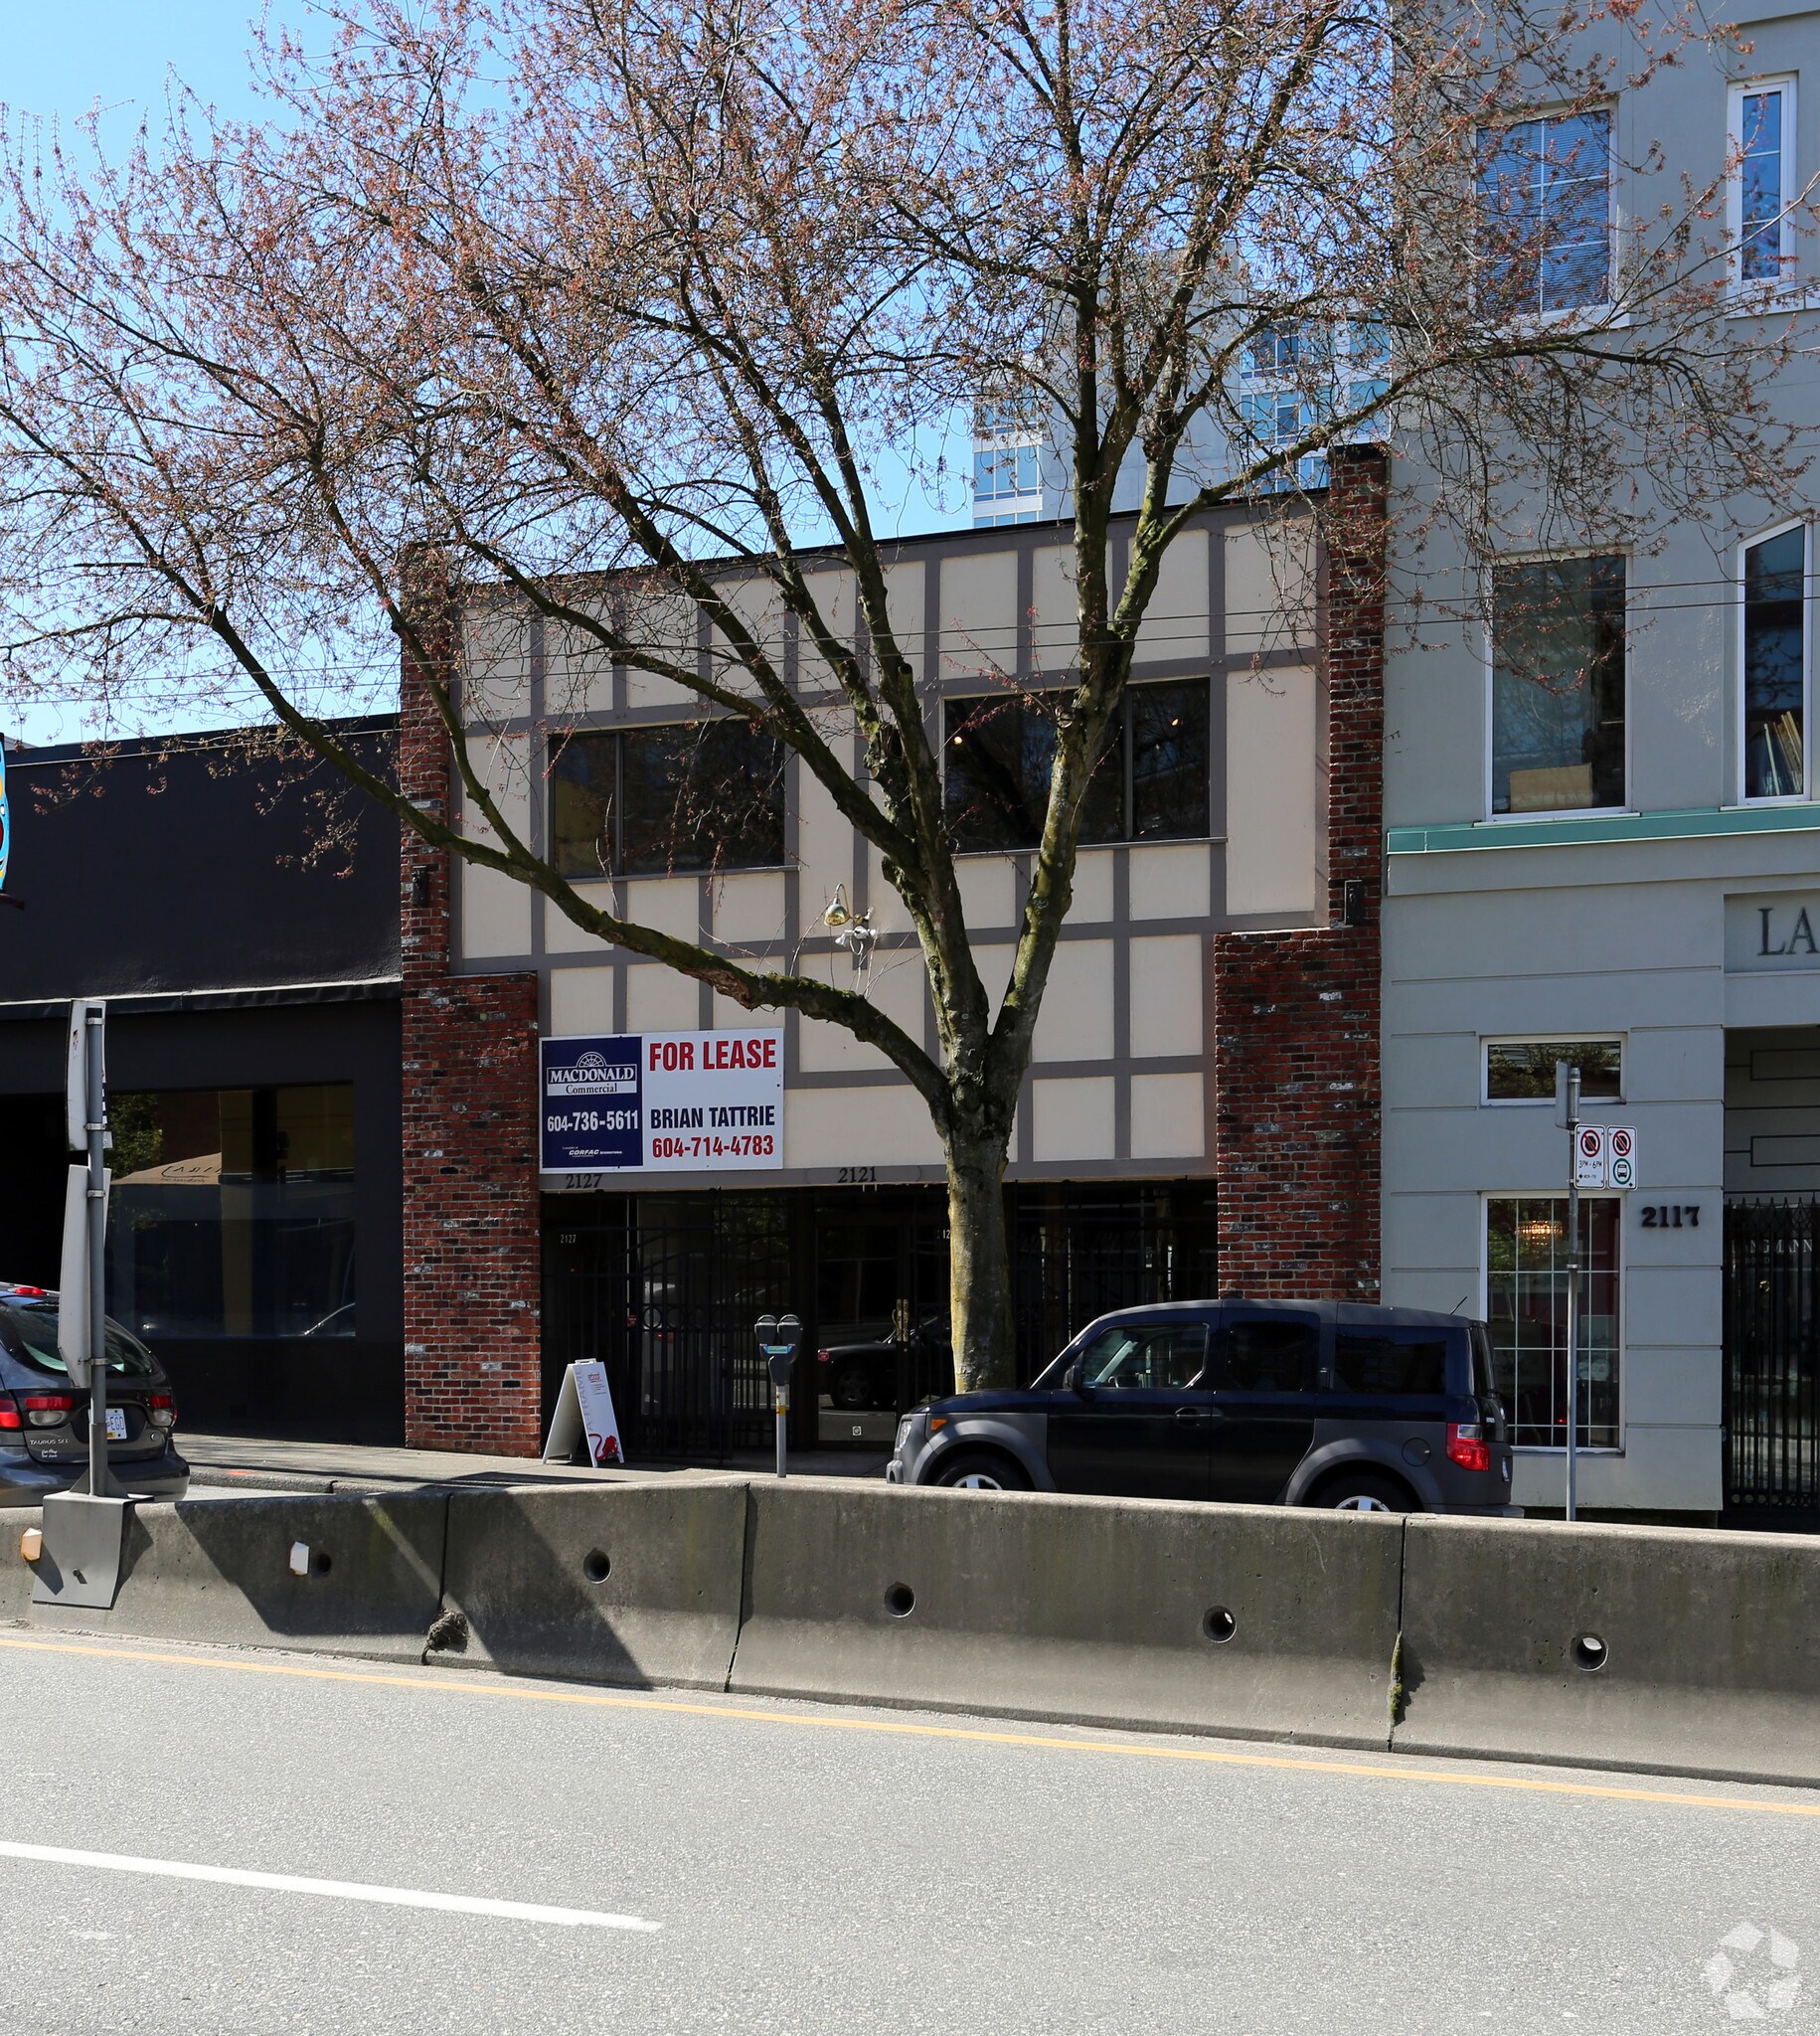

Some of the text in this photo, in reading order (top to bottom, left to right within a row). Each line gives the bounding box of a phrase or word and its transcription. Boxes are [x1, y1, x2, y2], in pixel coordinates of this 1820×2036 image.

[1757, 907, 1820, 955] LA
[650, 1039, 776, 1071] FOR LEASE
[550, 1067, 634, 1084] MACDONALD
[566, 1083, 617, 1095] Commercial
[547, 1109, 638, 1131] 604-736-5611
[650, 1105, 775, 1129] BRIAN TATTRIE
[652, 1134, 773, 1158] 604-714-4783
[566, 1173, 603, 1189] 2127
[837, 1166, 877, 1183] 2121
[1641, 1205, 1701, 1229] 2117
[560, 1234, 577, 1243] 2127
